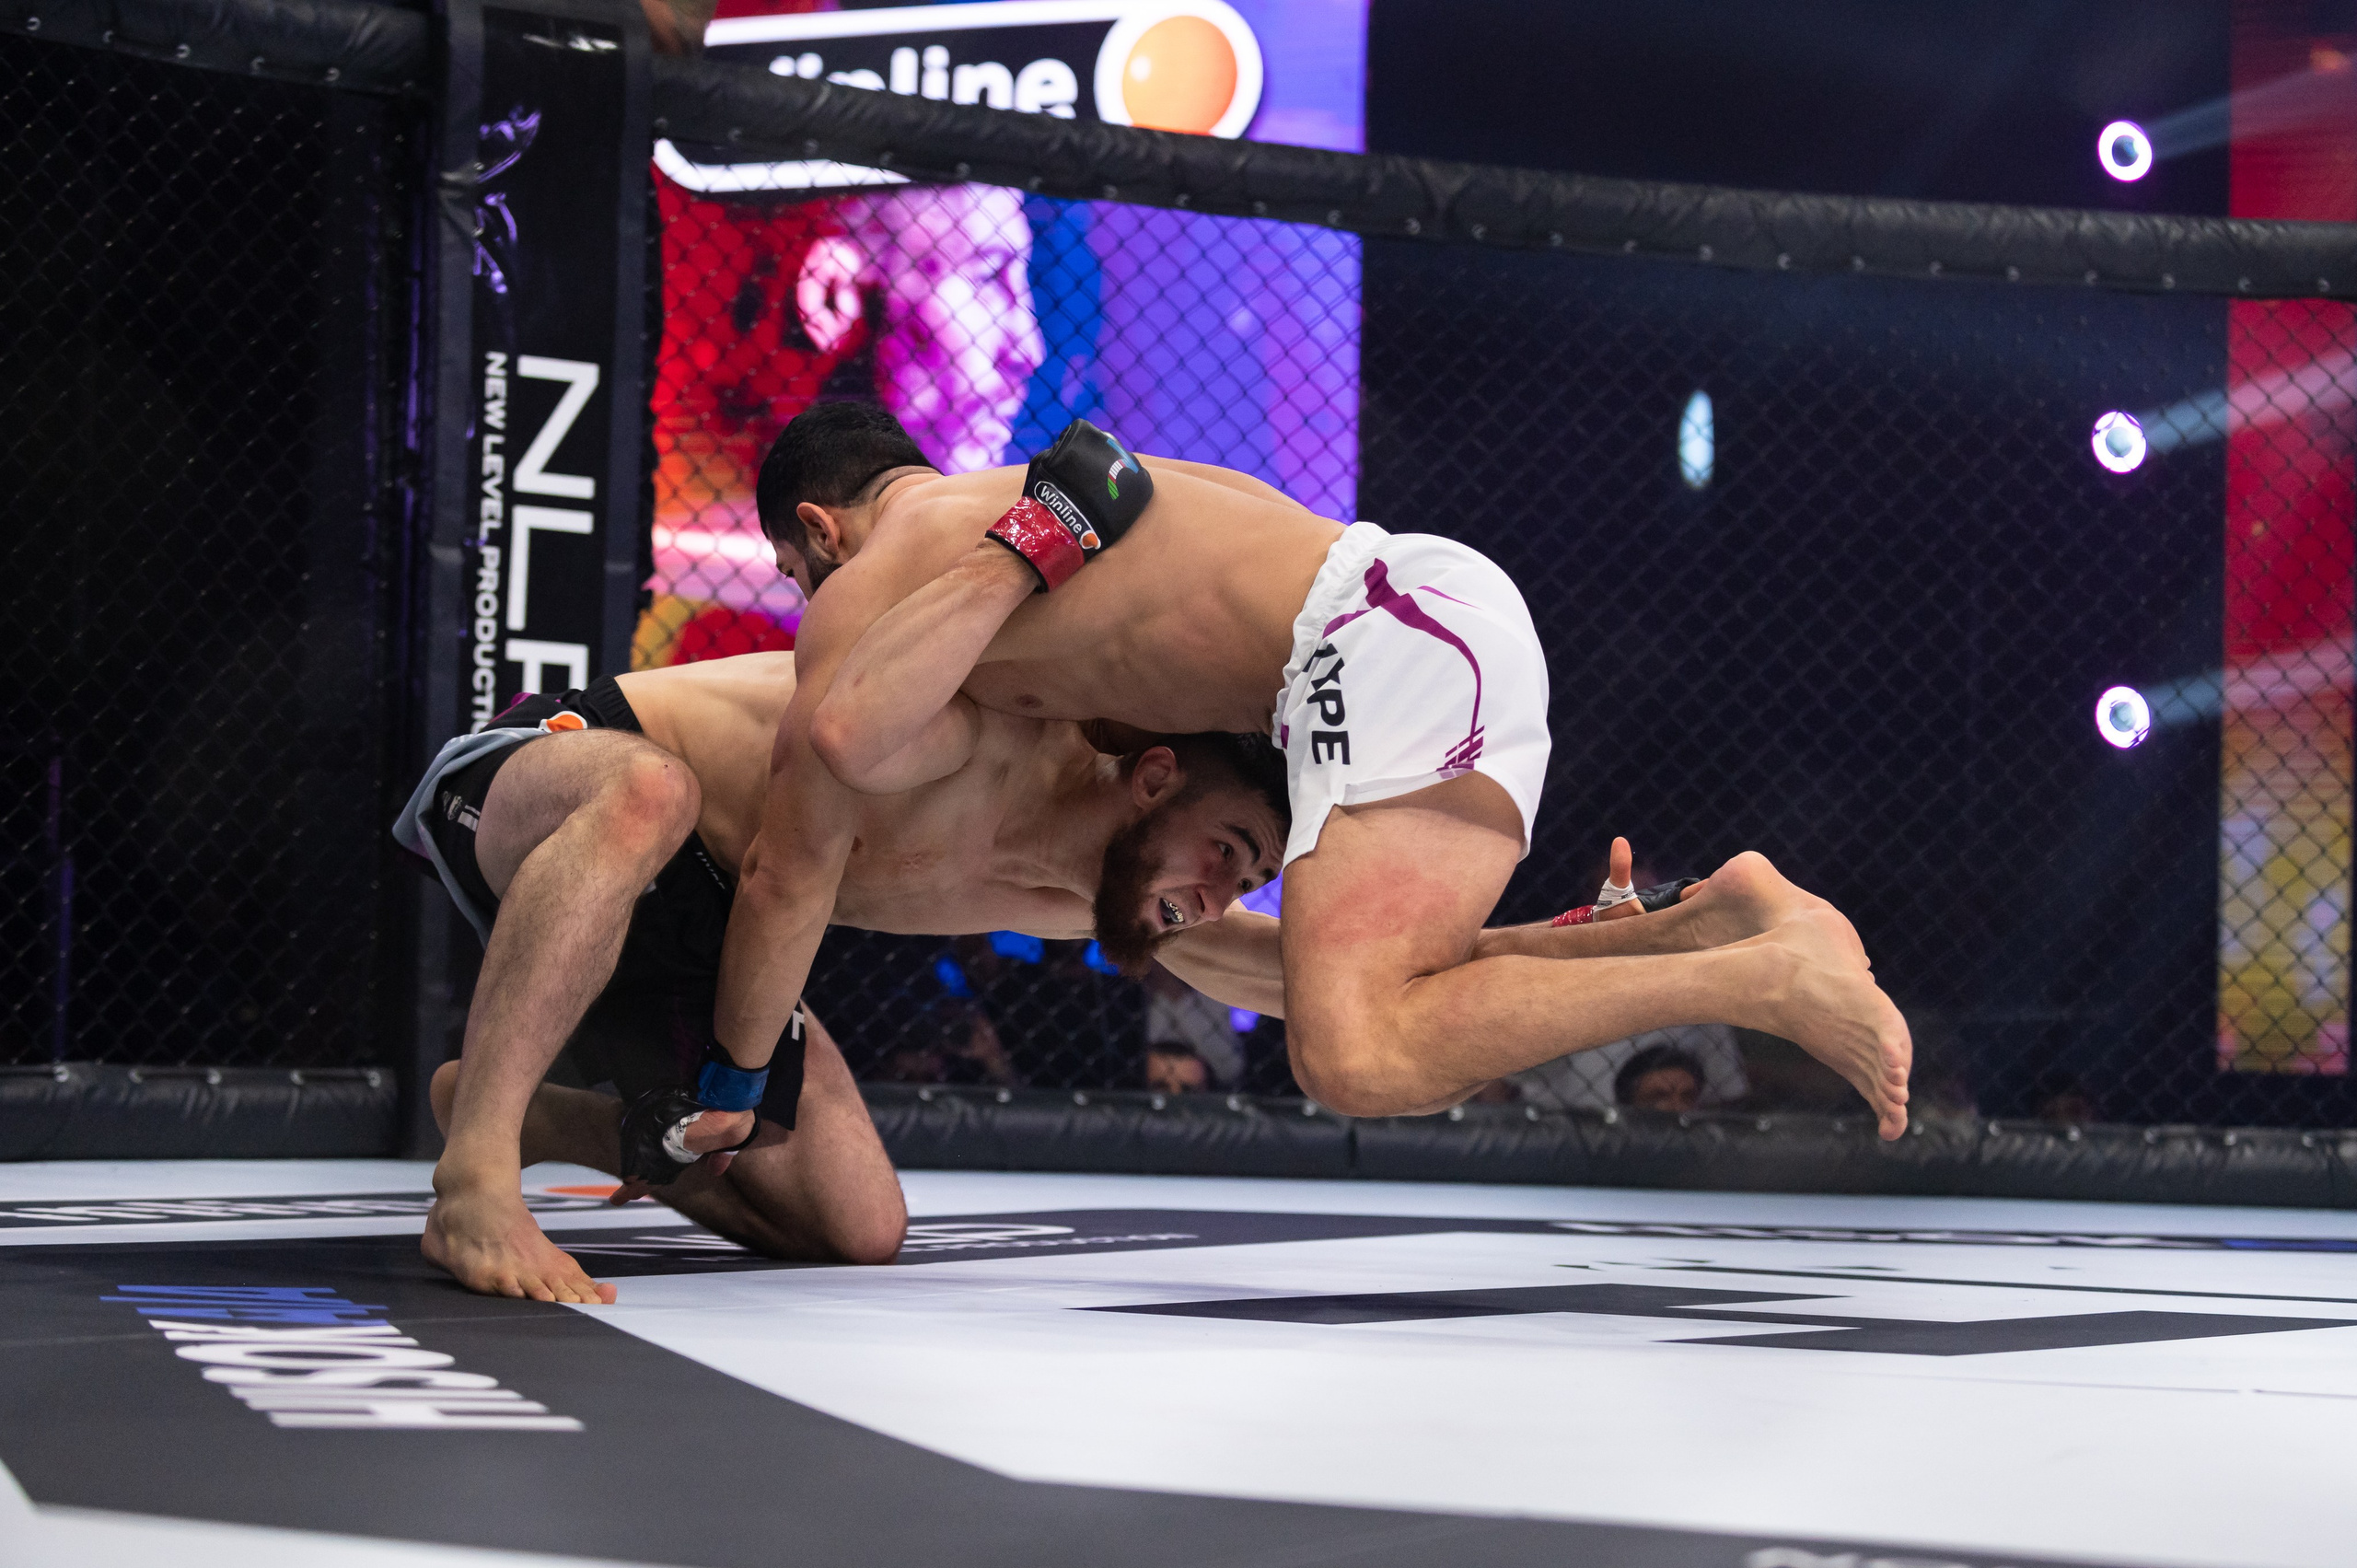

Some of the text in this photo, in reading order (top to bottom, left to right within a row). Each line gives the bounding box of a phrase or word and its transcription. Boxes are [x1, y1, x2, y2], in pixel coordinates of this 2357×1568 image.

[484, 351, 507, 430] NEW
[479, 434, 505, 541] LEVEL
[1040, 485, 1083, 534] Winline
